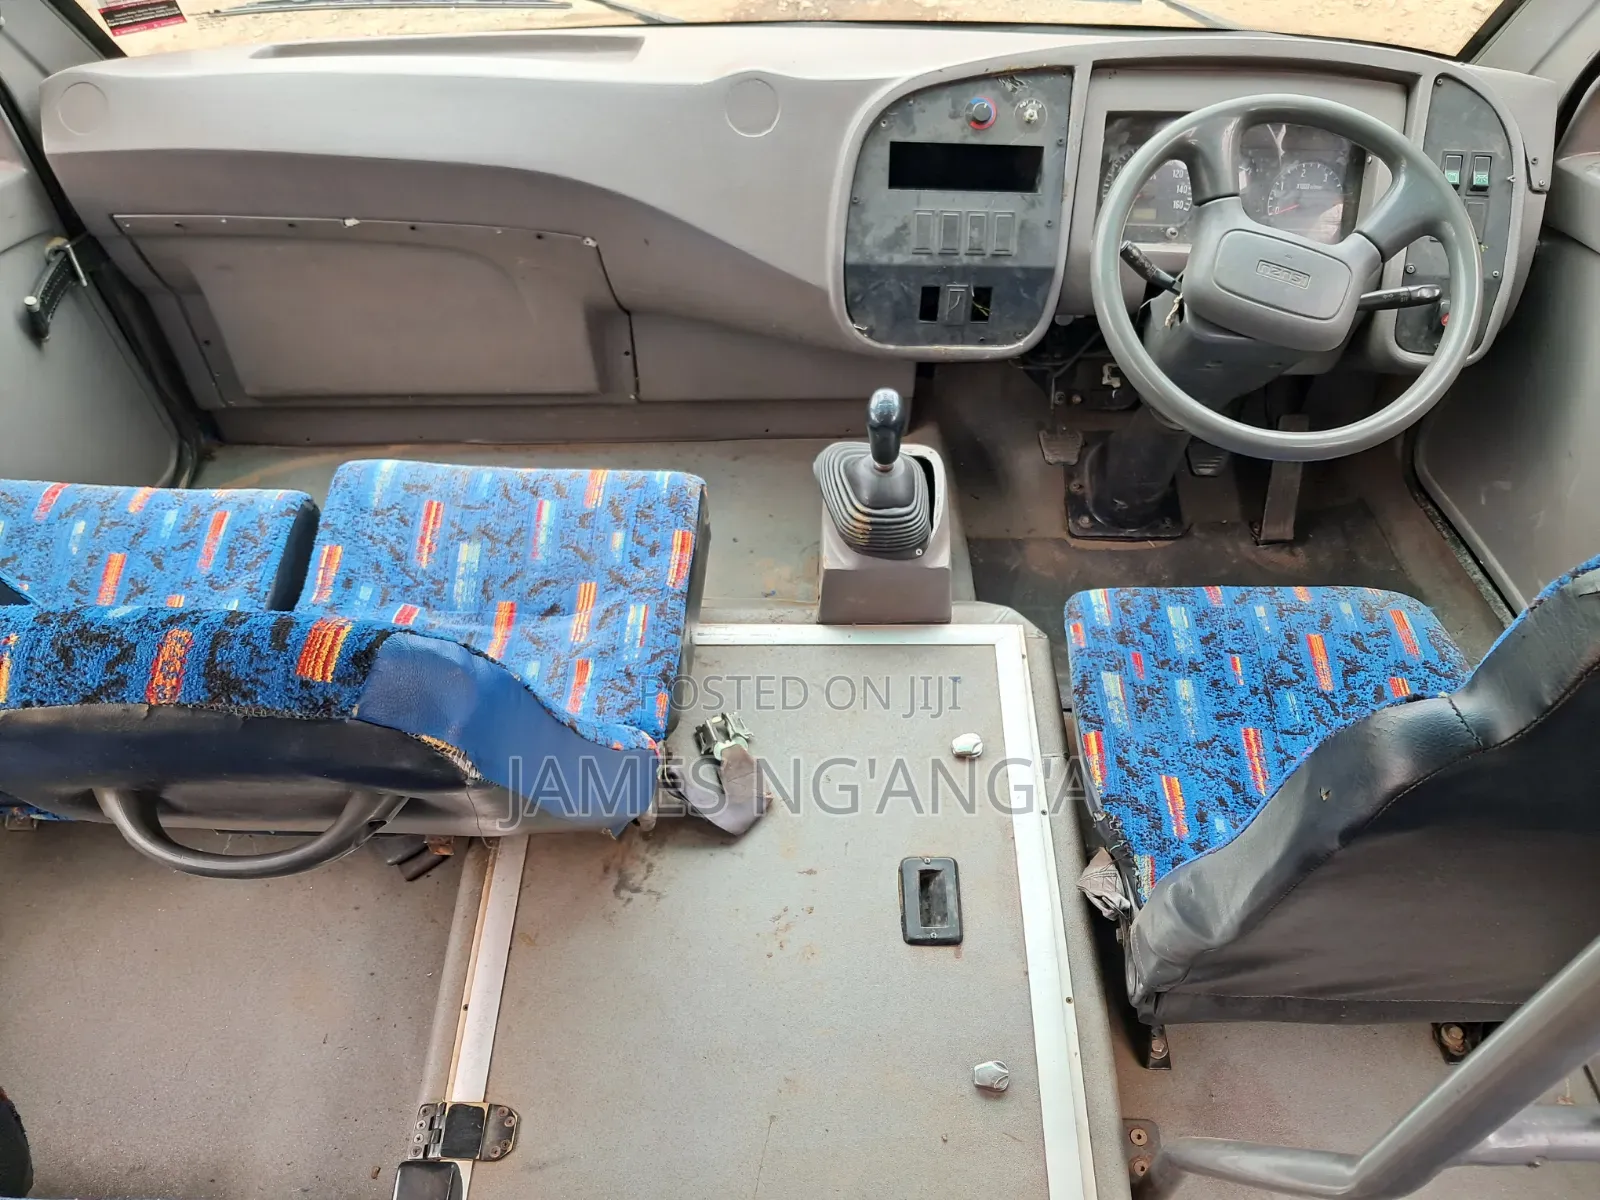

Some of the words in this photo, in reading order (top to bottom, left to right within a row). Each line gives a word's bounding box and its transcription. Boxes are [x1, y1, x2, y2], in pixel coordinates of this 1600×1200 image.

[1172, 169, 1184, 179] 120
[1300, 168, 1307, 178] 2
[1322, 173, 1328, 183] 3
[1176, 184, 1188, 194] 140
[1172, 200, 1184, 210] 160
[1259, 262, 1308, 287] ISUZU
